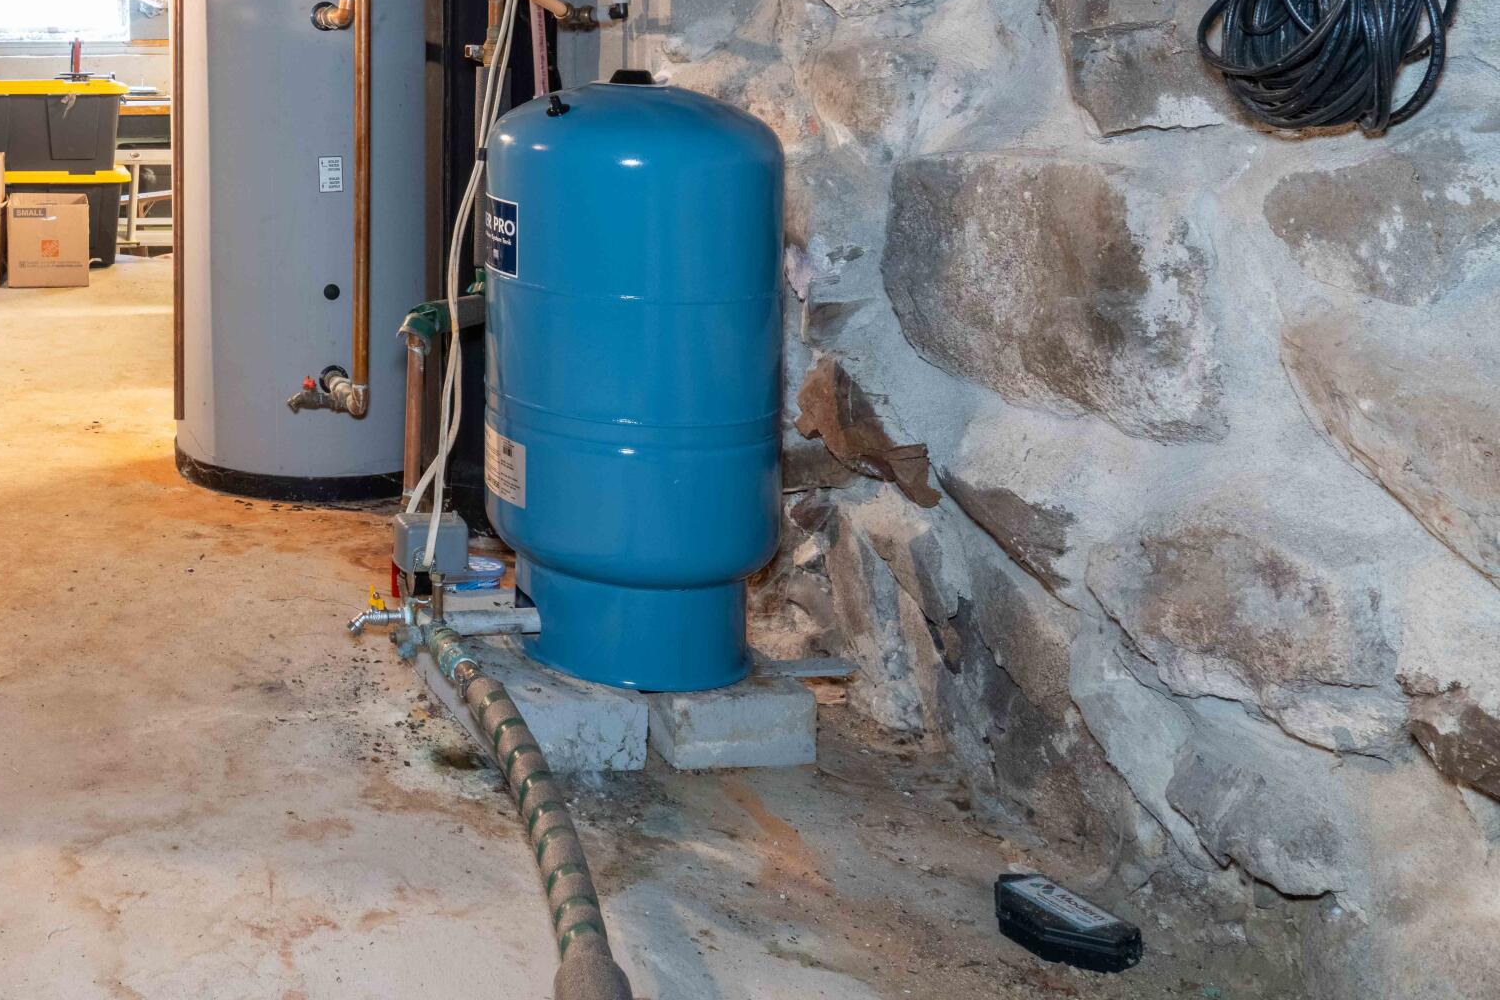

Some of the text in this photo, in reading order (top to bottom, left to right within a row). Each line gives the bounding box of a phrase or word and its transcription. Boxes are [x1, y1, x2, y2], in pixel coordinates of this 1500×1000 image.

[16, 209, 44, 217] SMALL
[493, 215, 515, 236] PRO
[1055, 894, 1106, 921] Modern
